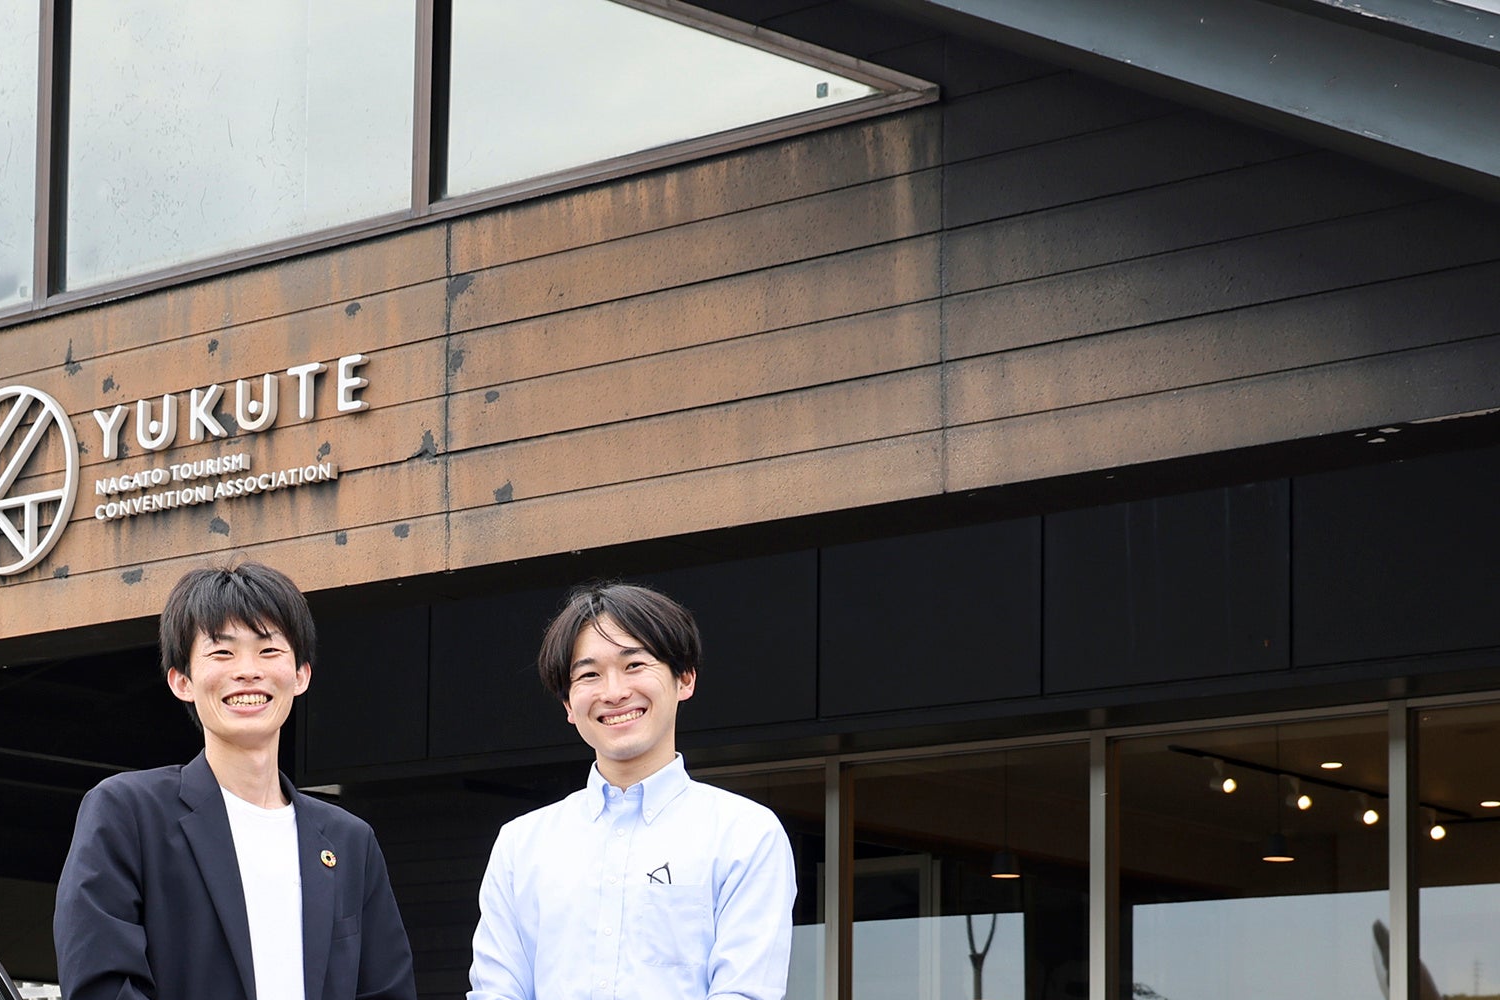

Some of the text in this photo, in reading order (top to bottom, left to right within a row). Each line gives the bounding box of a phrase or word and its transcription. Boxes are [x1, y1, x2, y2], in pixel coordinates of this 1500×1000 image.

[92, 353, 370, 460] YUKUTE
[94, 462, 339, 521] CONVENTION ASSOCIATION
[95, 452, 251, 496] NAGATO TOURISM
